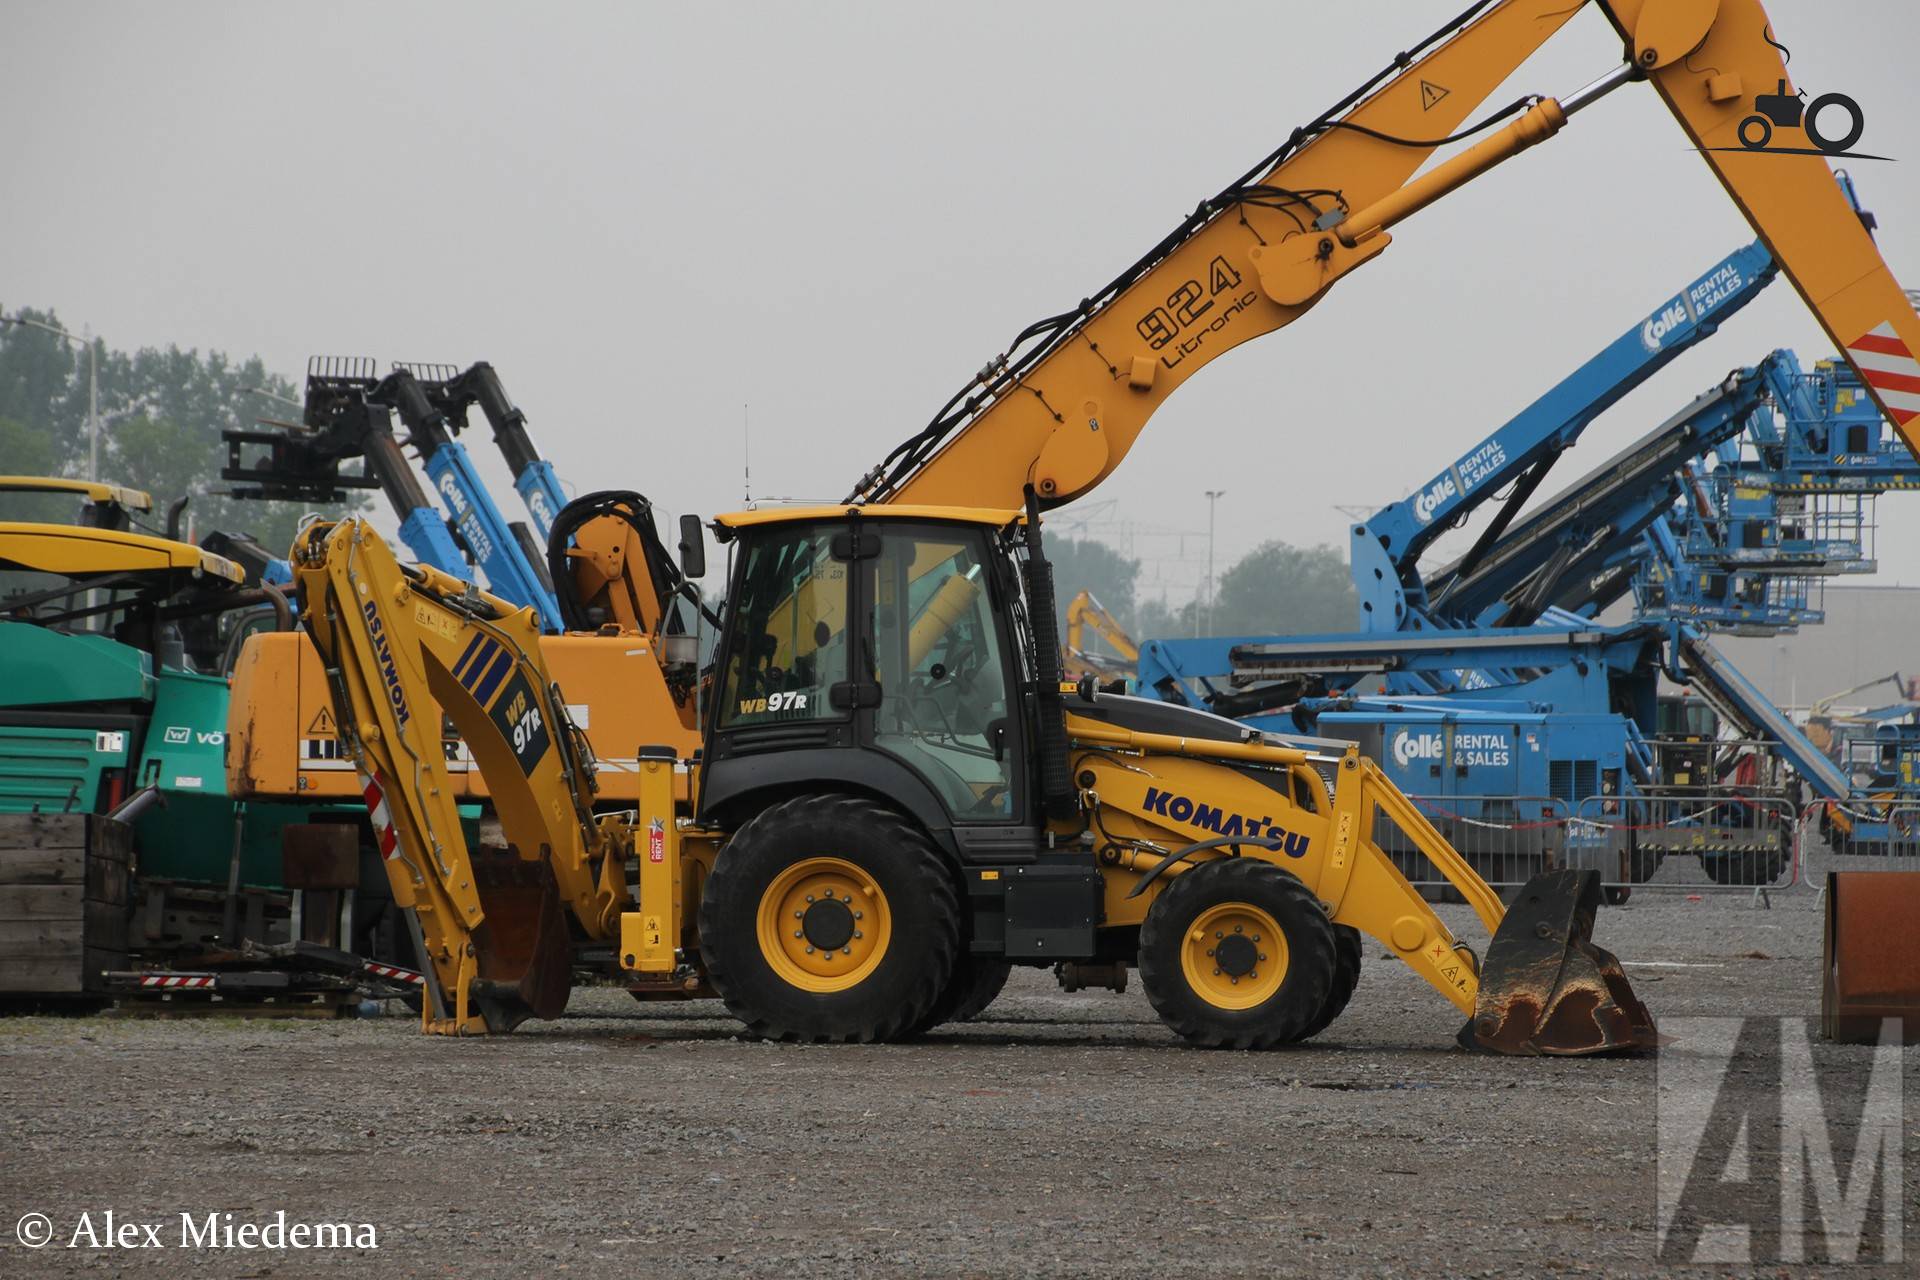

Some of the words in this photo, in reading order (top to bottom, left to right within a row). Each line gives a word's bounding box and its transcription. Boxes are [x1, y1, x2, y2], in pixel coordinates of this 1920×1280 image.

[1136, 255, 1242, 350] 924
[1691, 264, 1737, 303] RENTAL
[1696, 302, 1706, 316] &
[1705, 274, 1742, 308] SALES
[1161, 291, 1257, 369] Litronic
[1644, 301, 1687, 348] Collé
[1459, 440, 1501, 477] RENTAL
[1464, 477, 1473, 489] &
[1472, 450, 1506, 482] SALES
[1415, 475, 1456, 521] Collé
[467, 529, 489, 563] SALES
[468, 513, 493, 556] RENTAL
[364, 600, 410, 724] KOMATSU
[505, 690, 526, 727] WB
[513, 707, 542, 754] 97R
[1394, 731, 1443, 766] Collé
[1454, 735, 1509, 750] RENTAL
[1454, 752, 1464, 766] &
[1466, 752, 1509, 766] SALES
[1142, 787, 1310, 858] KOMATSU
[655, 838, 663, 860] RENT
